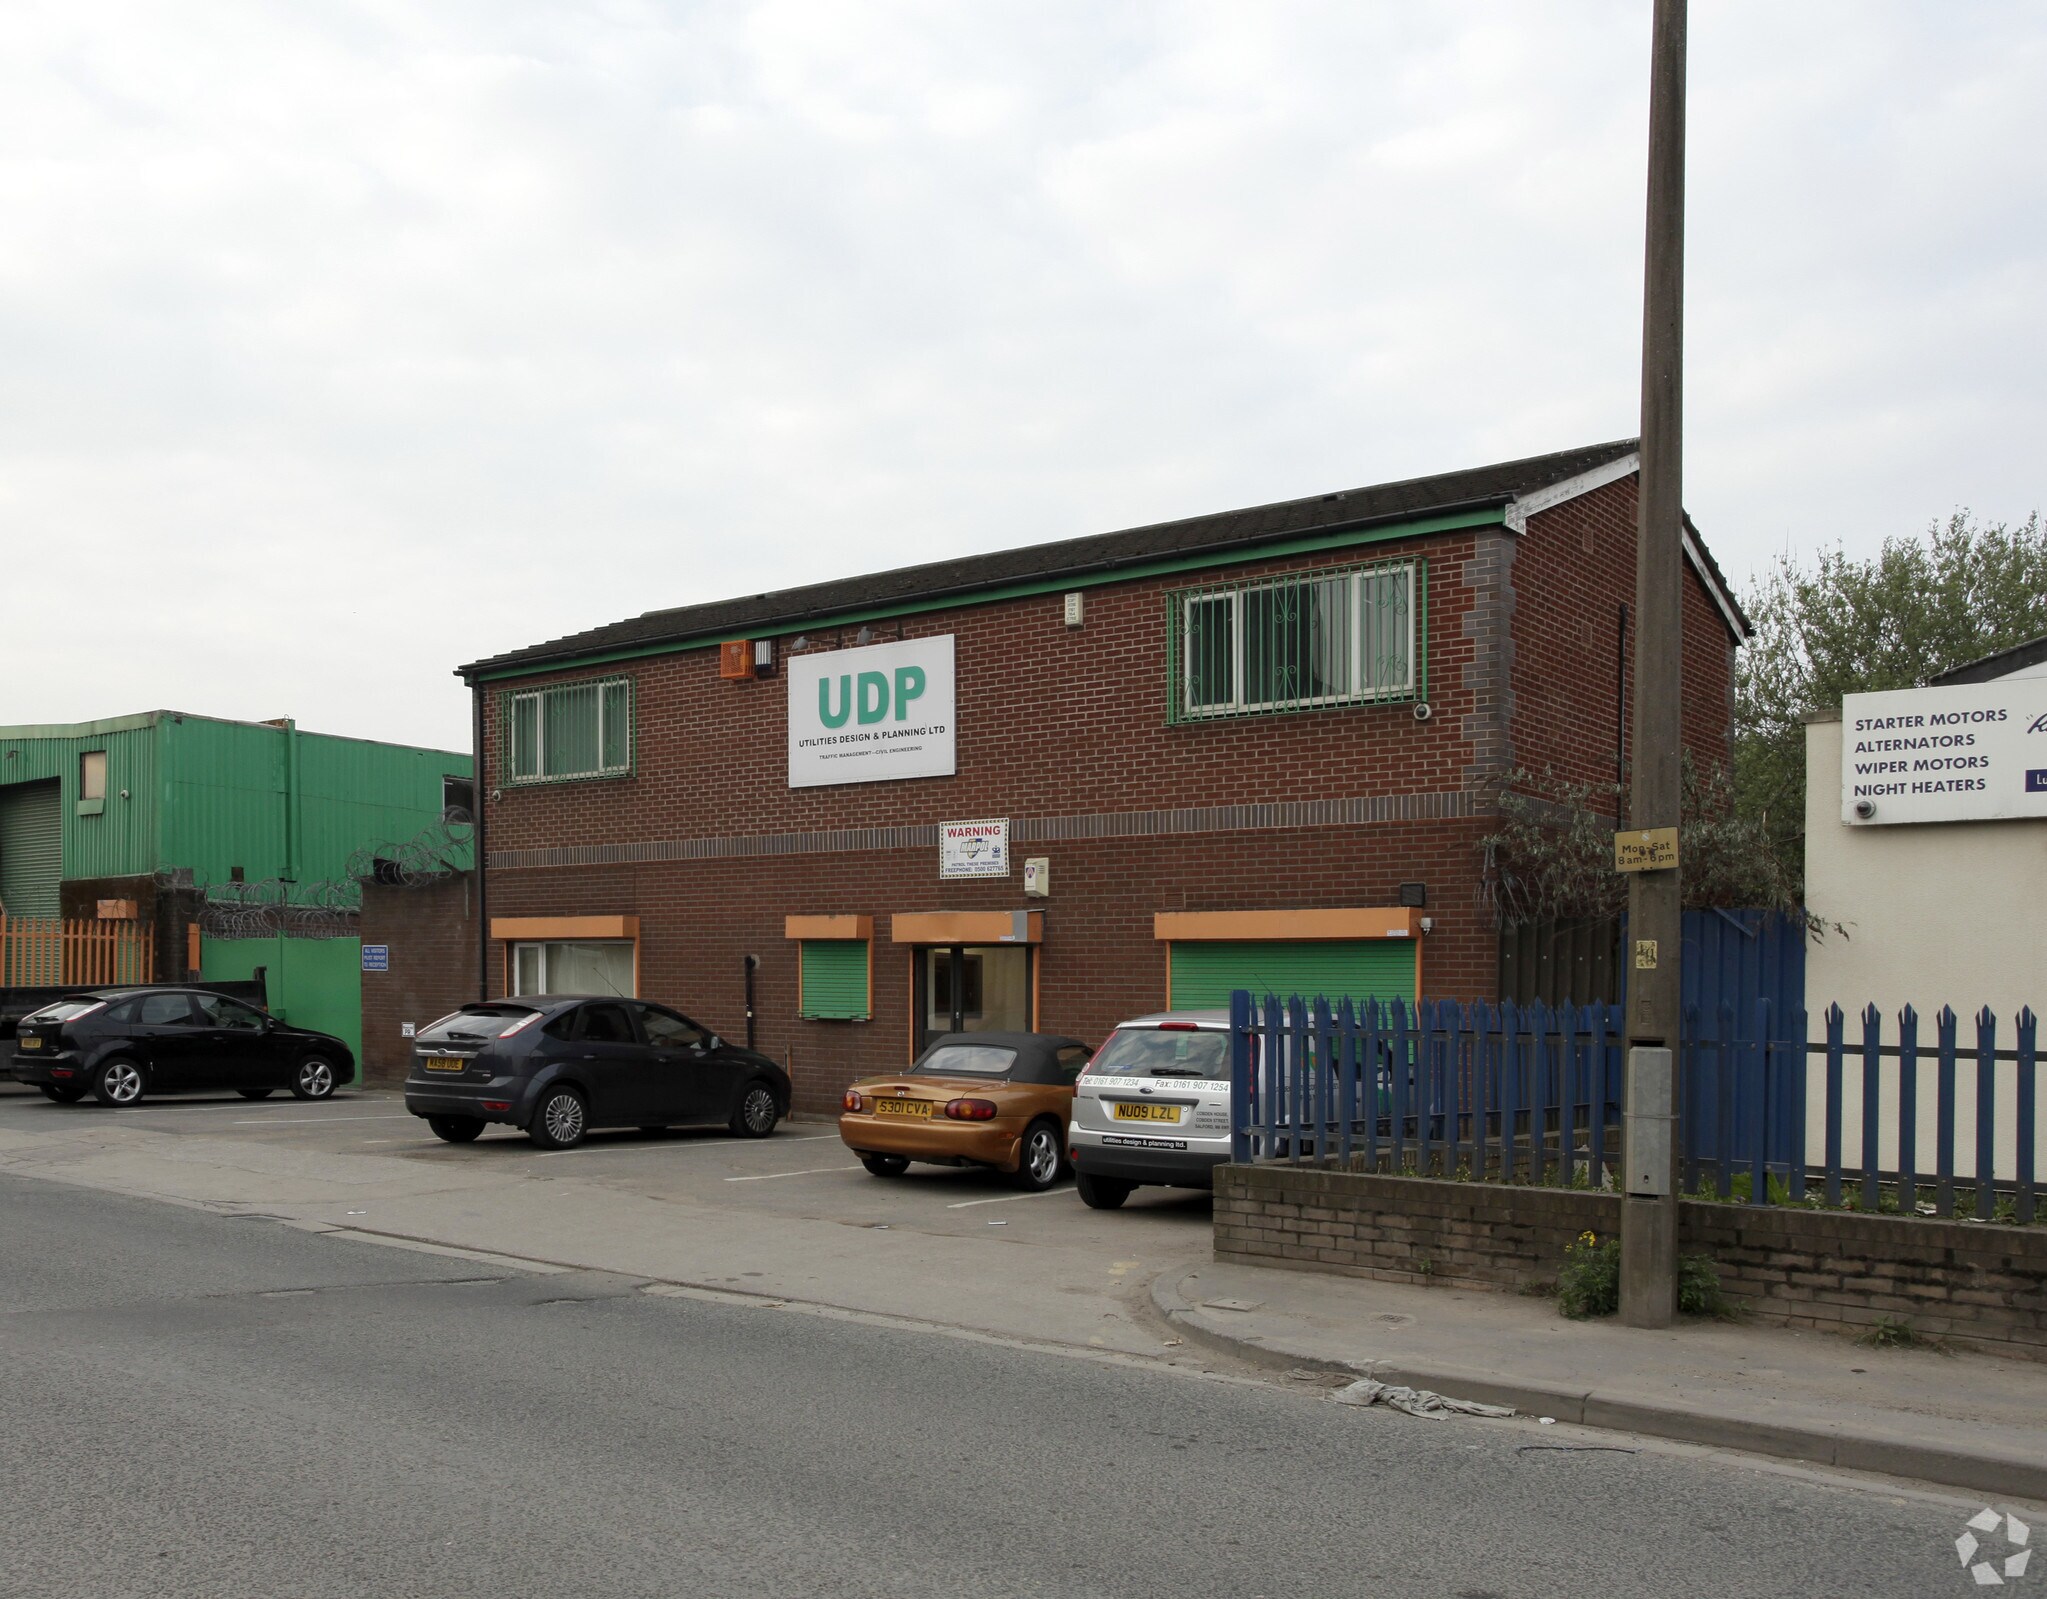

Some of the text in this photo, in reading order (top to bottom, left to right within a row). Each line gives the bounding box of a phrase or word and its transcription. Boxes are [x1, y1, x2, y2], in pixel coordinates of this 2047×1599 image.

[819, 665, 926, 729] UDP
[1855, 715, 1924, 731] STARTER
[1929, 709, 2008, 726] MOTORS
[799, 726, 946, 748] UTILITIES DESIGN & PLANNING LTD
[1854, 734, 1975, 753] ALTERNATORS
[889, 746, 923, 754] ENGINEERING
[1854, 755, 1989, 775] WIPER MOTORS
[1854, 778, 1986, 797] NIGHT HEATERS
[947, 825, 1001, 838] WARNING
[1093, 1077, 1108, 1085] 0161
[1109, 1077, 1121, 1086] 907
[1123, 1078, 1140, 1086] 1234
[1154, 1079, 1229, 1092] Fax: 0161 907 1254
[906, 1102, 928, 1115] CVA
[1118, 1105, 1174, 1120] NU09 LZL
[1123, 1138, 1142, 1146] design
[1148, 1140, 1174, 1148] planning
